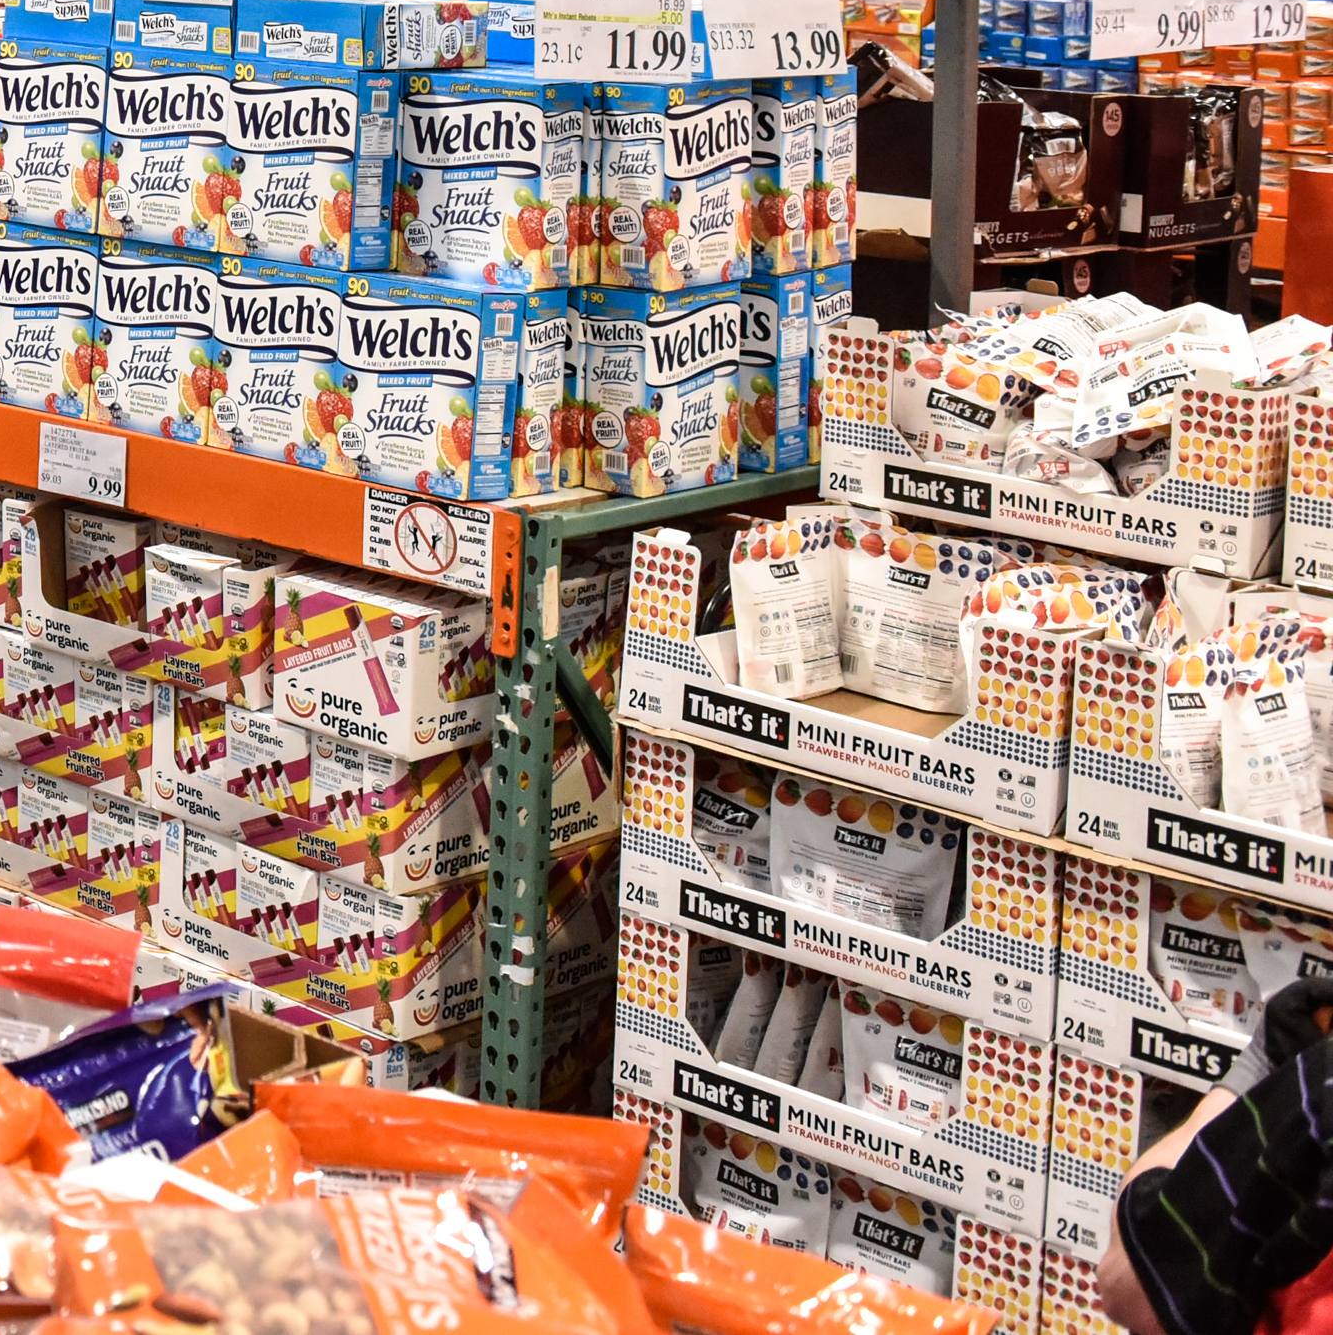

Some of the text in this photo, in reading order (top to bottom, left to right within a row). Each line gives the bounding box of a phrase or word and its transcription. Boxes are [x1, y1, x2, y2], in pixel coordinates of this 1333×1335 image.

[658, 0, 685, 11] 16.99
[1207, 5, 1235, 22] $8.66
[1095, 16, 1125, 34] $9.44
[1157, 11, 1200, 48] 9.99
[1253, 3, 1303, 38] 12.99
[607, 28, 686, 72] 11.99
[711, 29, 755, 50] $13.32
[771, 29, 841, 70] 13.99
[541, 42, 583, 64] 23.1¢
[1, 74, 100, 110] Welch's
[409, 77, 431, 94] 90
[114, 86, 225, 125] Welch's
[237, 100, 351, 141] Welch's
[410, 111, 537, 153] Welch's
[266, 171, 311, 193] Fruit
[254, 190, 318, 213] Snacks
[1149, 223, 1196, 238] NUGGETS
[349, 315, 473, 360] Welch's
[89, 476, 121, 498] 9.99
[829, 472, 847, 492] 24
[889, 472, 954, 505] That's
[371, 489, 407, 504] DANGER
[370, 515, 394, 525] REACH
[371, 504, 397, 515] DO NOT
[448, 506, 488, 521] PELIGRO
[999, 491, 1177, 538] MINI FRUIT BARS
[999, 509, 1176, 549] STRAWBERRY MANGO BLUEBERRY
[370, 537, 391, 546] CLIMB
[459, 535, 486, 546] AGARRE
[322, 691, 362, 715] pure
[320, 712, 387, 744] organic
[1154, 818, 1238, 864] That's
